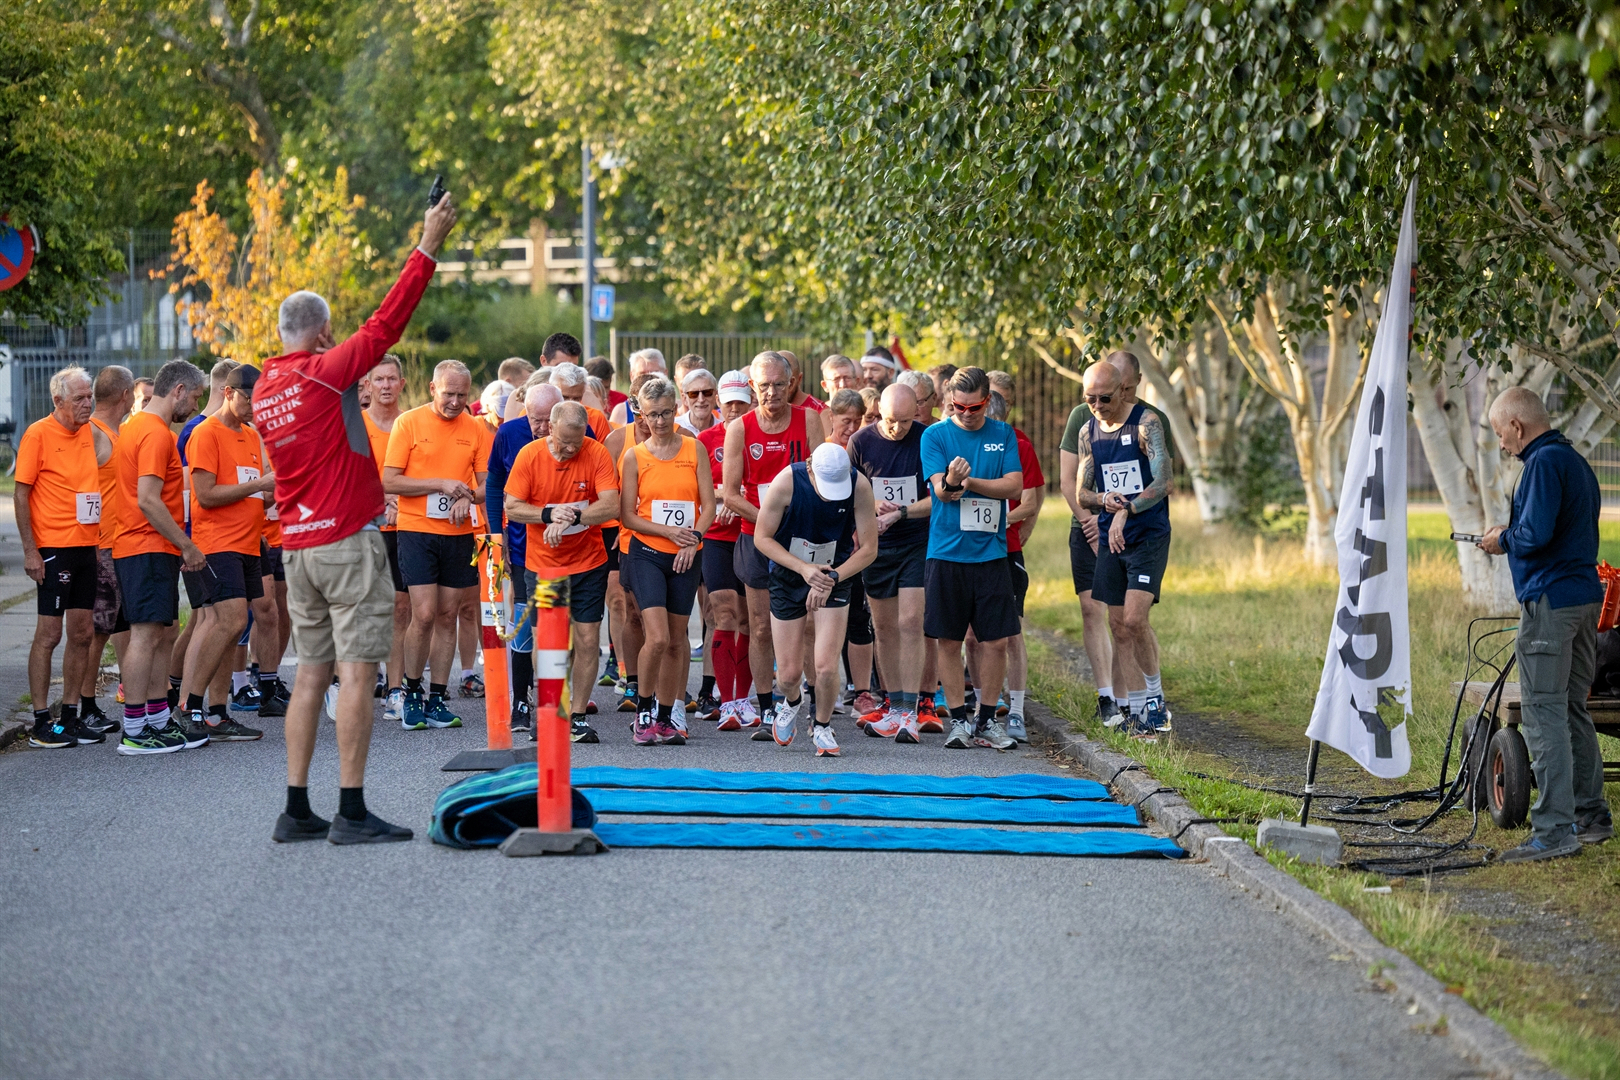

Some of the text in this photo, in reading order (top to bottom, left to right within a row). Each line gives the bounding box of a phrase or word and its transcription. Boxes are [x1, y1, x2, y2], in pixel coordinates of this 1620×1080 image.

[266, 413, 296, 431] CLUB
[983, 443, 1005, 452] SDC
[1110, 471, 1129, 489] 97
[884, 485, 904, 501] 31
[86, 501, 100, 517] 75
[973, 507, 992, 524] 18
[662, 509, 685, 527] 79
[808, 550, 816, 562] 1
